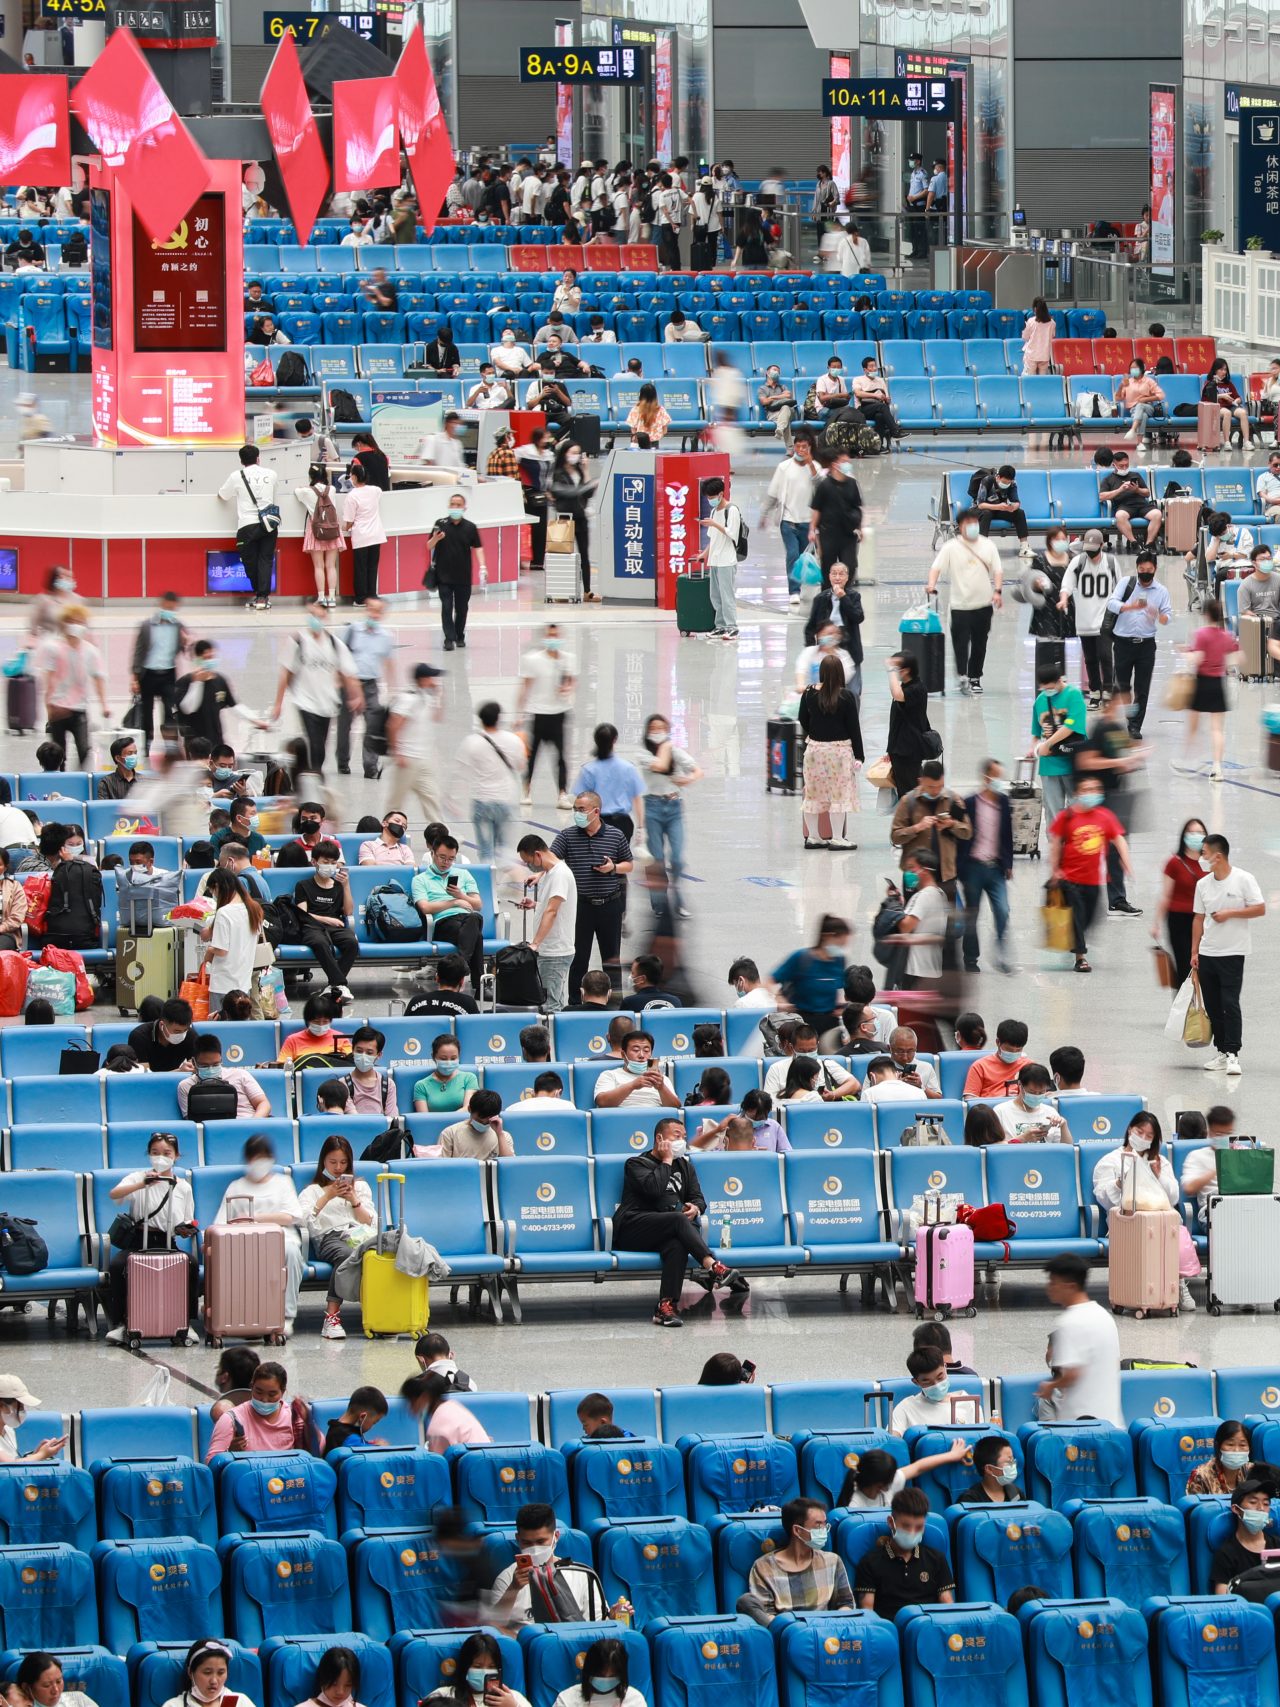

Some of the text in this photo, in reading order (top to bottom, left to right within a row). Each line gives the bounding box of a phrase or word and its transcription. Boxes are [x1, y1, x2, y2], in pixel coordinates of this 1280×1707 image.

[1254, 173, 1263, 194] Tea
[1266, 154, 1279, 215] 休闲茶吧
[624, 505, 644, 575] 自动售取
[1081, 574, 1109, 598] 00
[411, 1000, 428, 1011] GAME
[1009, 1193, 1059, 1201] 多宝电缆集团
[709, 1199, 761, 1208] 多宝电缆集团
[808, 1199, 860, 1208] 多宝电缆集团
[521, 1206, 574, 1214] 多宝电缆集团
[1196, 1437, 1215, 1448] 爽客
[634, 1460, 653, 1471] 爽客
[750, 1459, 767, 1470] 爽客
[517, 1469, 536, 1480] 爽客
[286, 1477, 305, 1489] 爽客
[419, 1548, 439, 1560] 爽客
[167, 1562, 188, 1575] 爽客
[294, 1561, 314, 1573] 爽客
[1219, 1626, 1239, 1638] 爽客
[841, 1640, 862, 1651] 爽客
[965, 1636, 986, 1648] 爽客
[718, 1643, 740, 1655] 爽客
